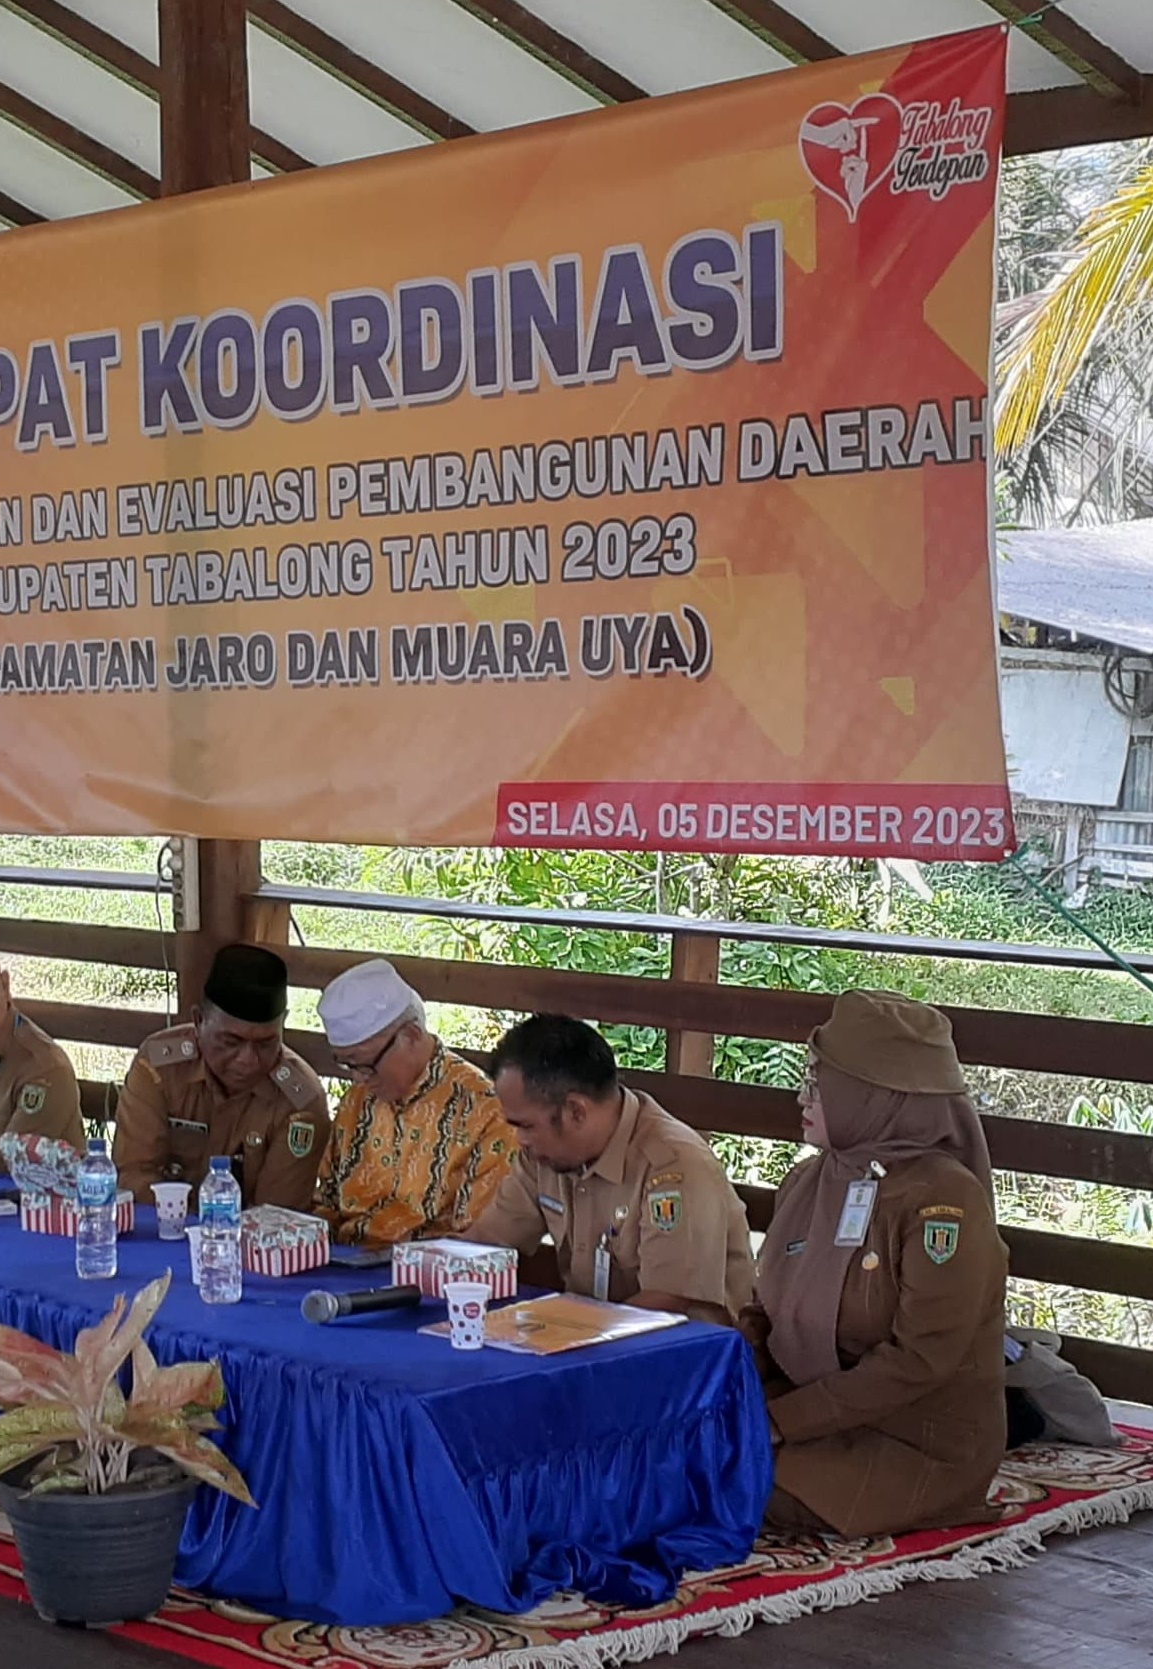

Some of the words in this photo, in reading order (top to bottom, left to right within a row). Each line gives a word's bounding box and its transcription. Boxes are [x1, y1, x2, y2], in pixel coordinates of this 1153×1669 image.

[897, 97, 993, 150] Tabalong
[891, 147, 989, 199] Terdepan
[138, 220, 785, 435] KOORDINASI
[31, 489, 108, 543] DAN
[118, 468, 316, 536] EVALUASI
[329, 423, 724, 518] PEMBANGUNAN
[739, 396, 988, 480] DAERAH
[144, 539, 373, 604] TABALONG
[380, 529, 550, 593] TAHUN
[561, 514, 696, 580] 2023
[166, 633, 276, 688] JARO
[287, 628, 378, 683] DAN
[390, 614, 567, 681] MUARA
[582, 604, 713, 679] UYA)
[506, 801, 648, 839] SELASA,
[657, 803, 704, 839] 05
[707, 803, 902, 845] DESEMBER
[912, 805, 1007, 847] 2023
